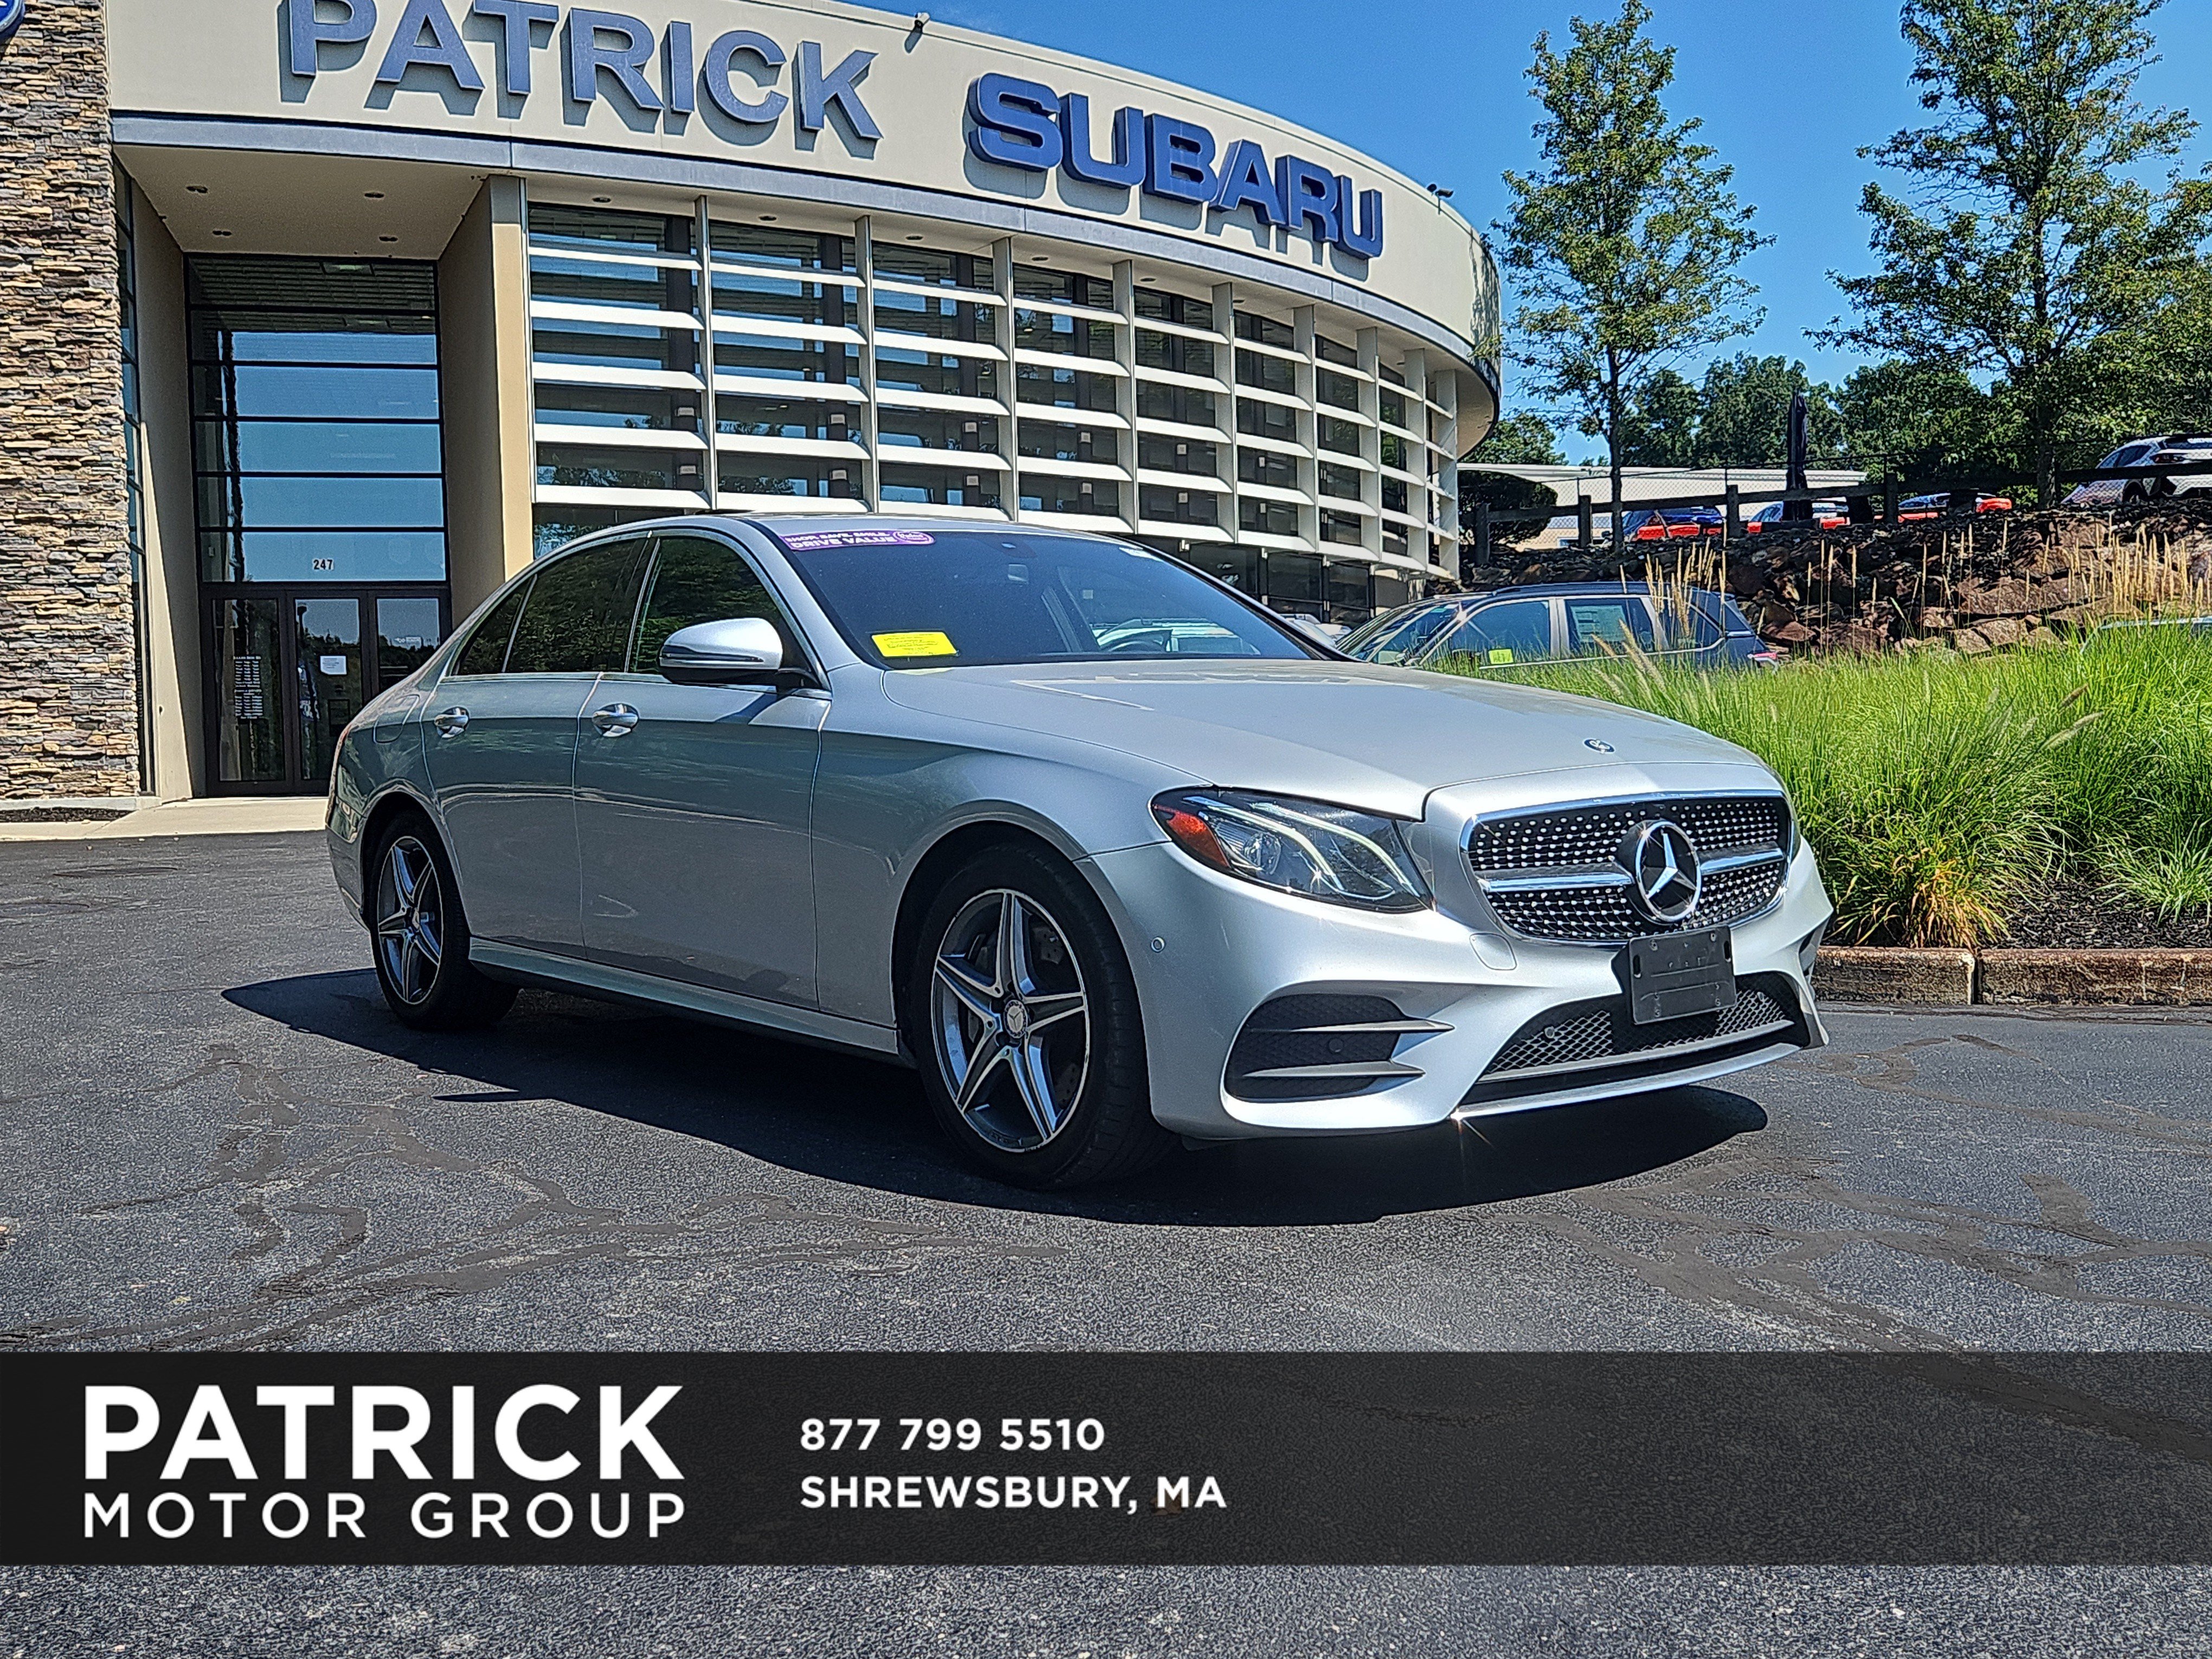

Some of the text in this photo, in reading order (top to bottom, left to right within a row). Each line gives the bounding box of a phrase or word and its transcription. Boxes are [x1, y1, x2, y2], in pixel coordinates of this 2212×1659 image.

[290, 0, 1384, 259] PATRICK SUBARU
[790, 539, 843, 548] DRIVE
[313, 558, 333, 570] 247
